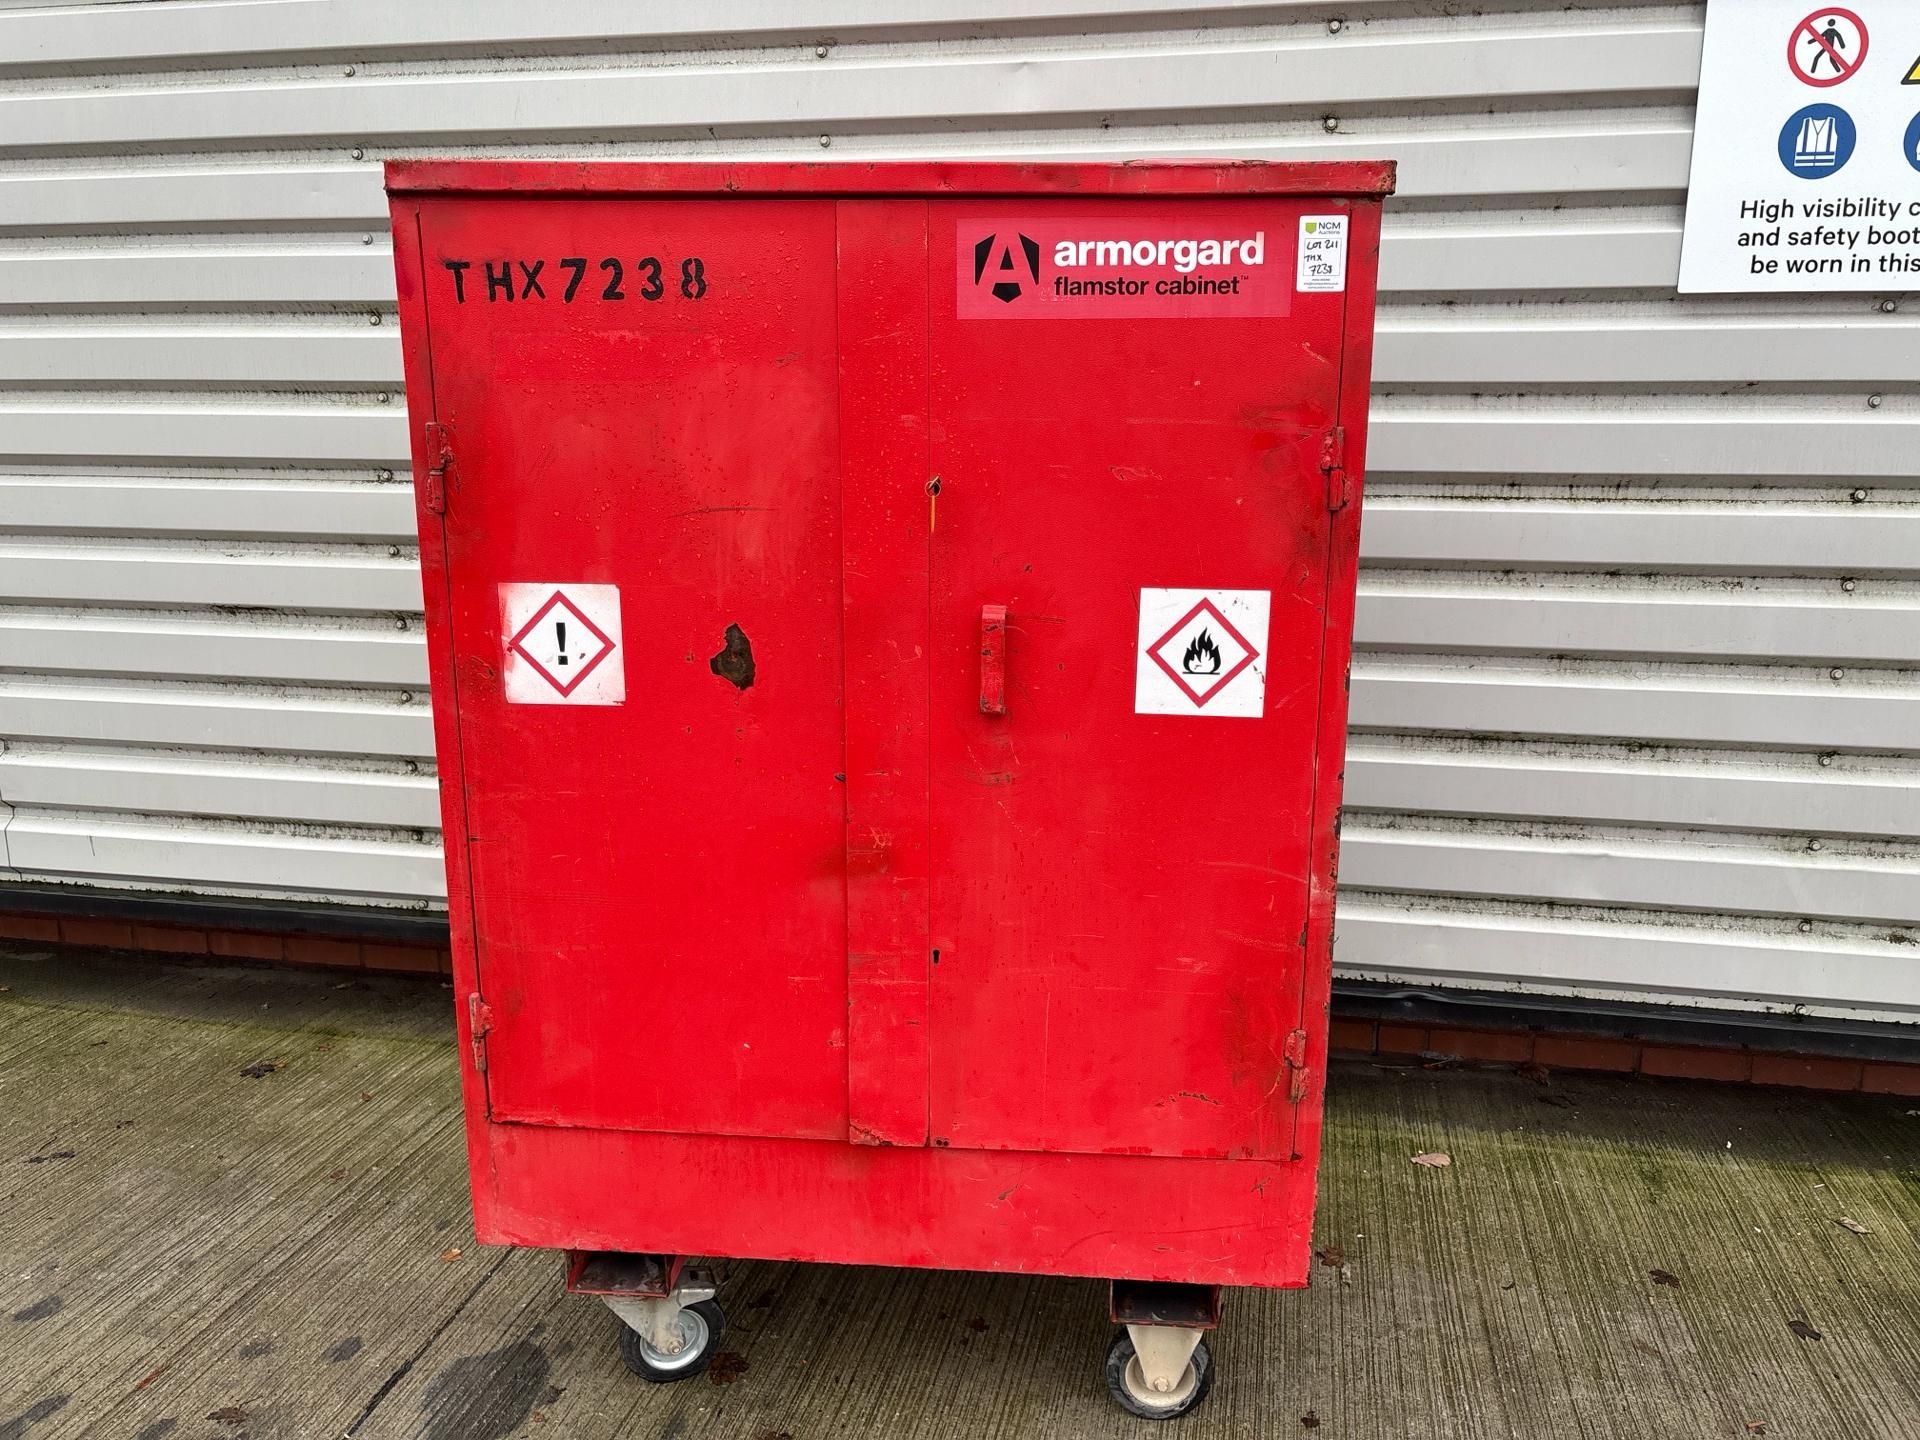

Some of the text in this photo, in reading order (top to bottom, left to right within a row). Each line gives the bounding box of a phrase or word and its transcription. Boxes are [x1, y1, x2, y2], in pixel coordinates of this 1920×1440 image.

[1740, 198, 1794, 223] High
[1803, 197, 1901, 222] visibility
[1319, 222, 1340, 230] NCM
[1737, 226, 1781, 247] and
[1787, 225, 1860, 250] safety
[1053, 231, 1265, 273] armorgard
[1750, 253, 1920, 274] be worn in this
[1053, 276, 1149, 297] flamstor
